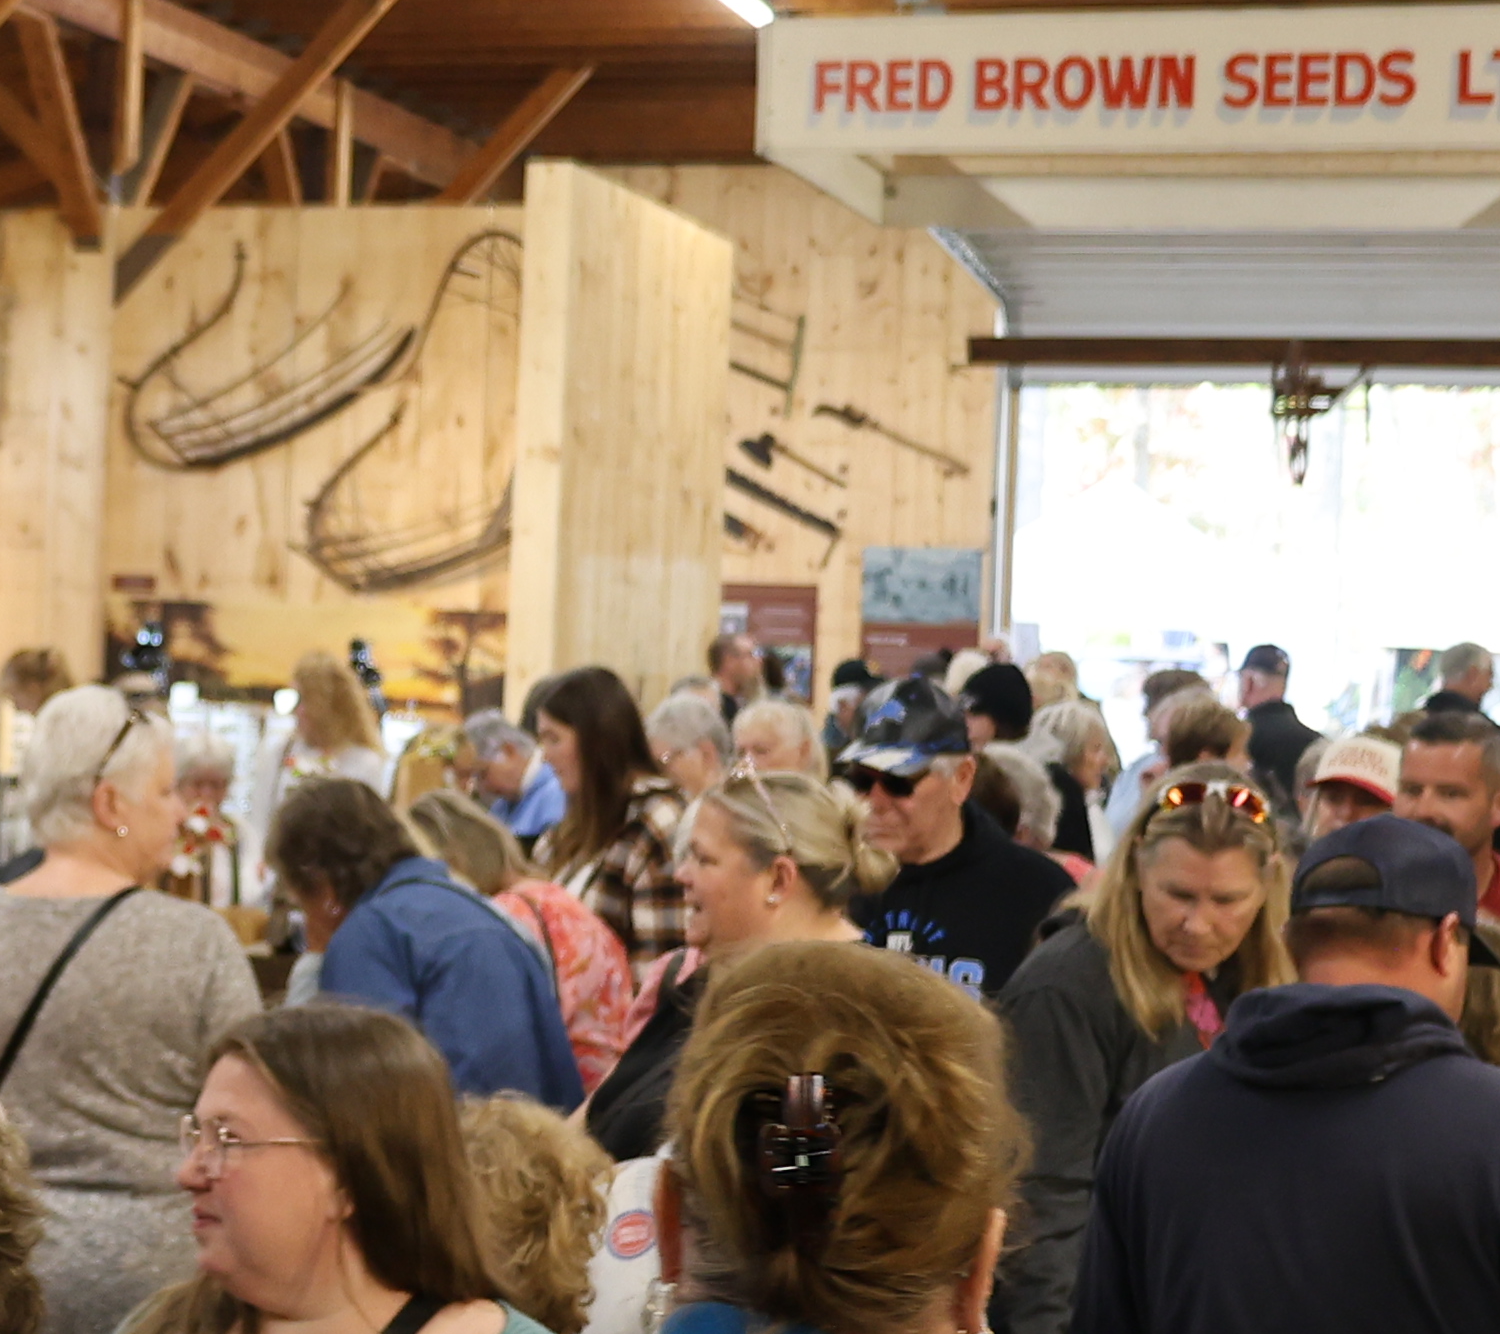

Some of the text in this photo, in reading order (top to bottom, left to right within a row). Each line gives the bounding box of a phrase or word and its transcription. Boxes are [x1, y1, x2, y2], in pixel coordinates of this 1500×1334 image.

[812, 59, 953, 114] FRED
[973, 54, 1196, 112] BROWN
[1221, 49, 1417, 109] SEEDS
